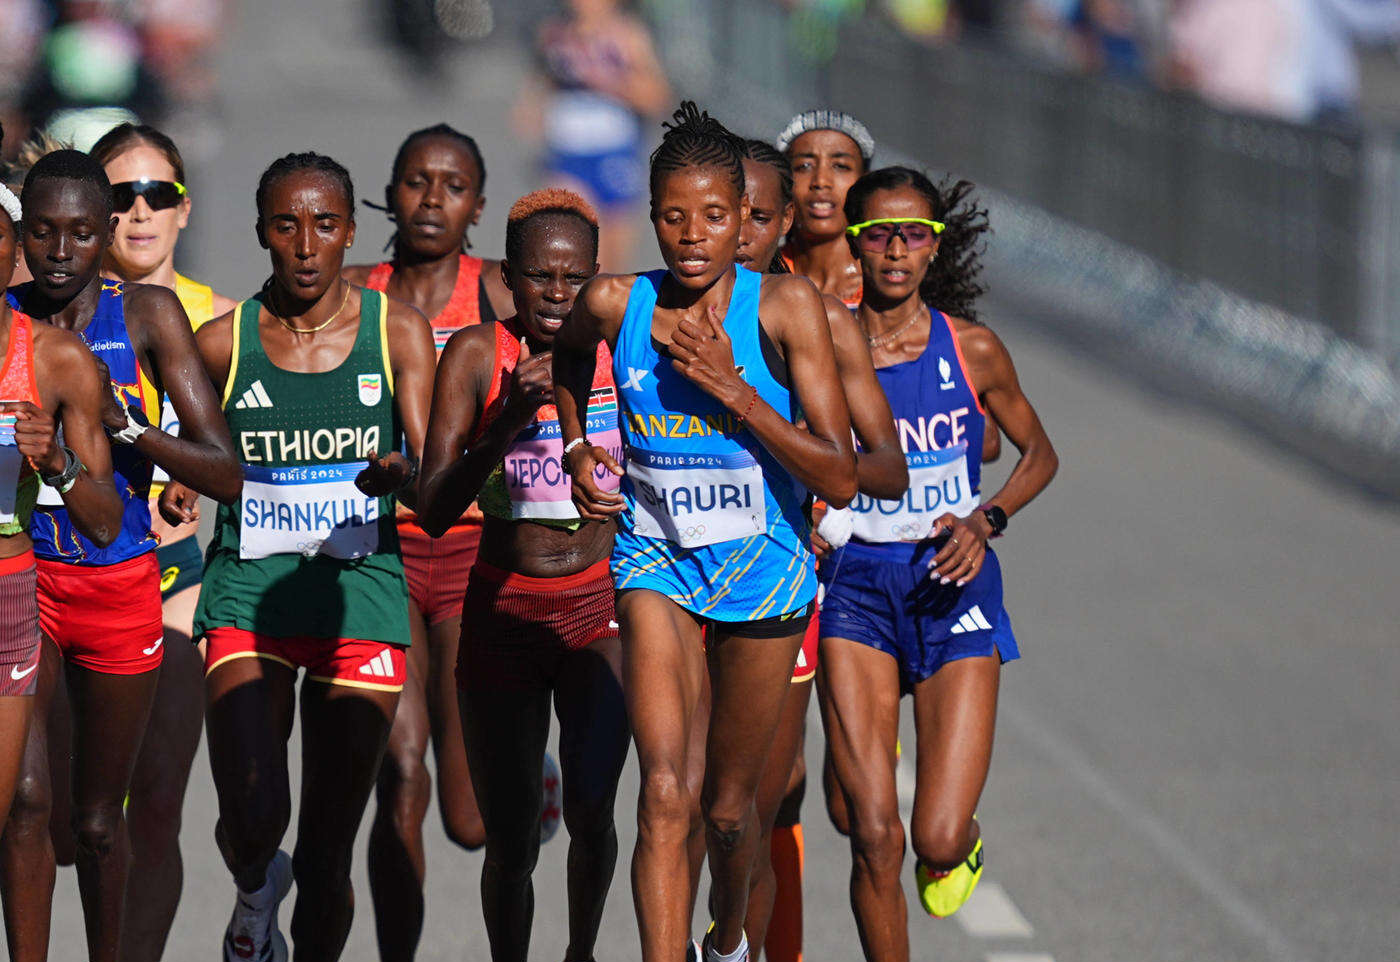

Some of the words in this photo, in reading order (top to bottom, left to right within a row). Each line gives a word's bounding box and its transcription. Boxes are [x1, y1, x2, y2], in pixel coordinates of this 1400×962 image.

[240, 426, 380, 462] ETHIOPIA
[649, 455, 685, 466] PARIS
[689, 456, 723, 466] 2024
[272, 469, 308, 481] PARIS
[311, 469, 344, 480] 2024
[245, 498, 377, 532] SHANKULE
[638, 479, 752, 517] SHAURI
